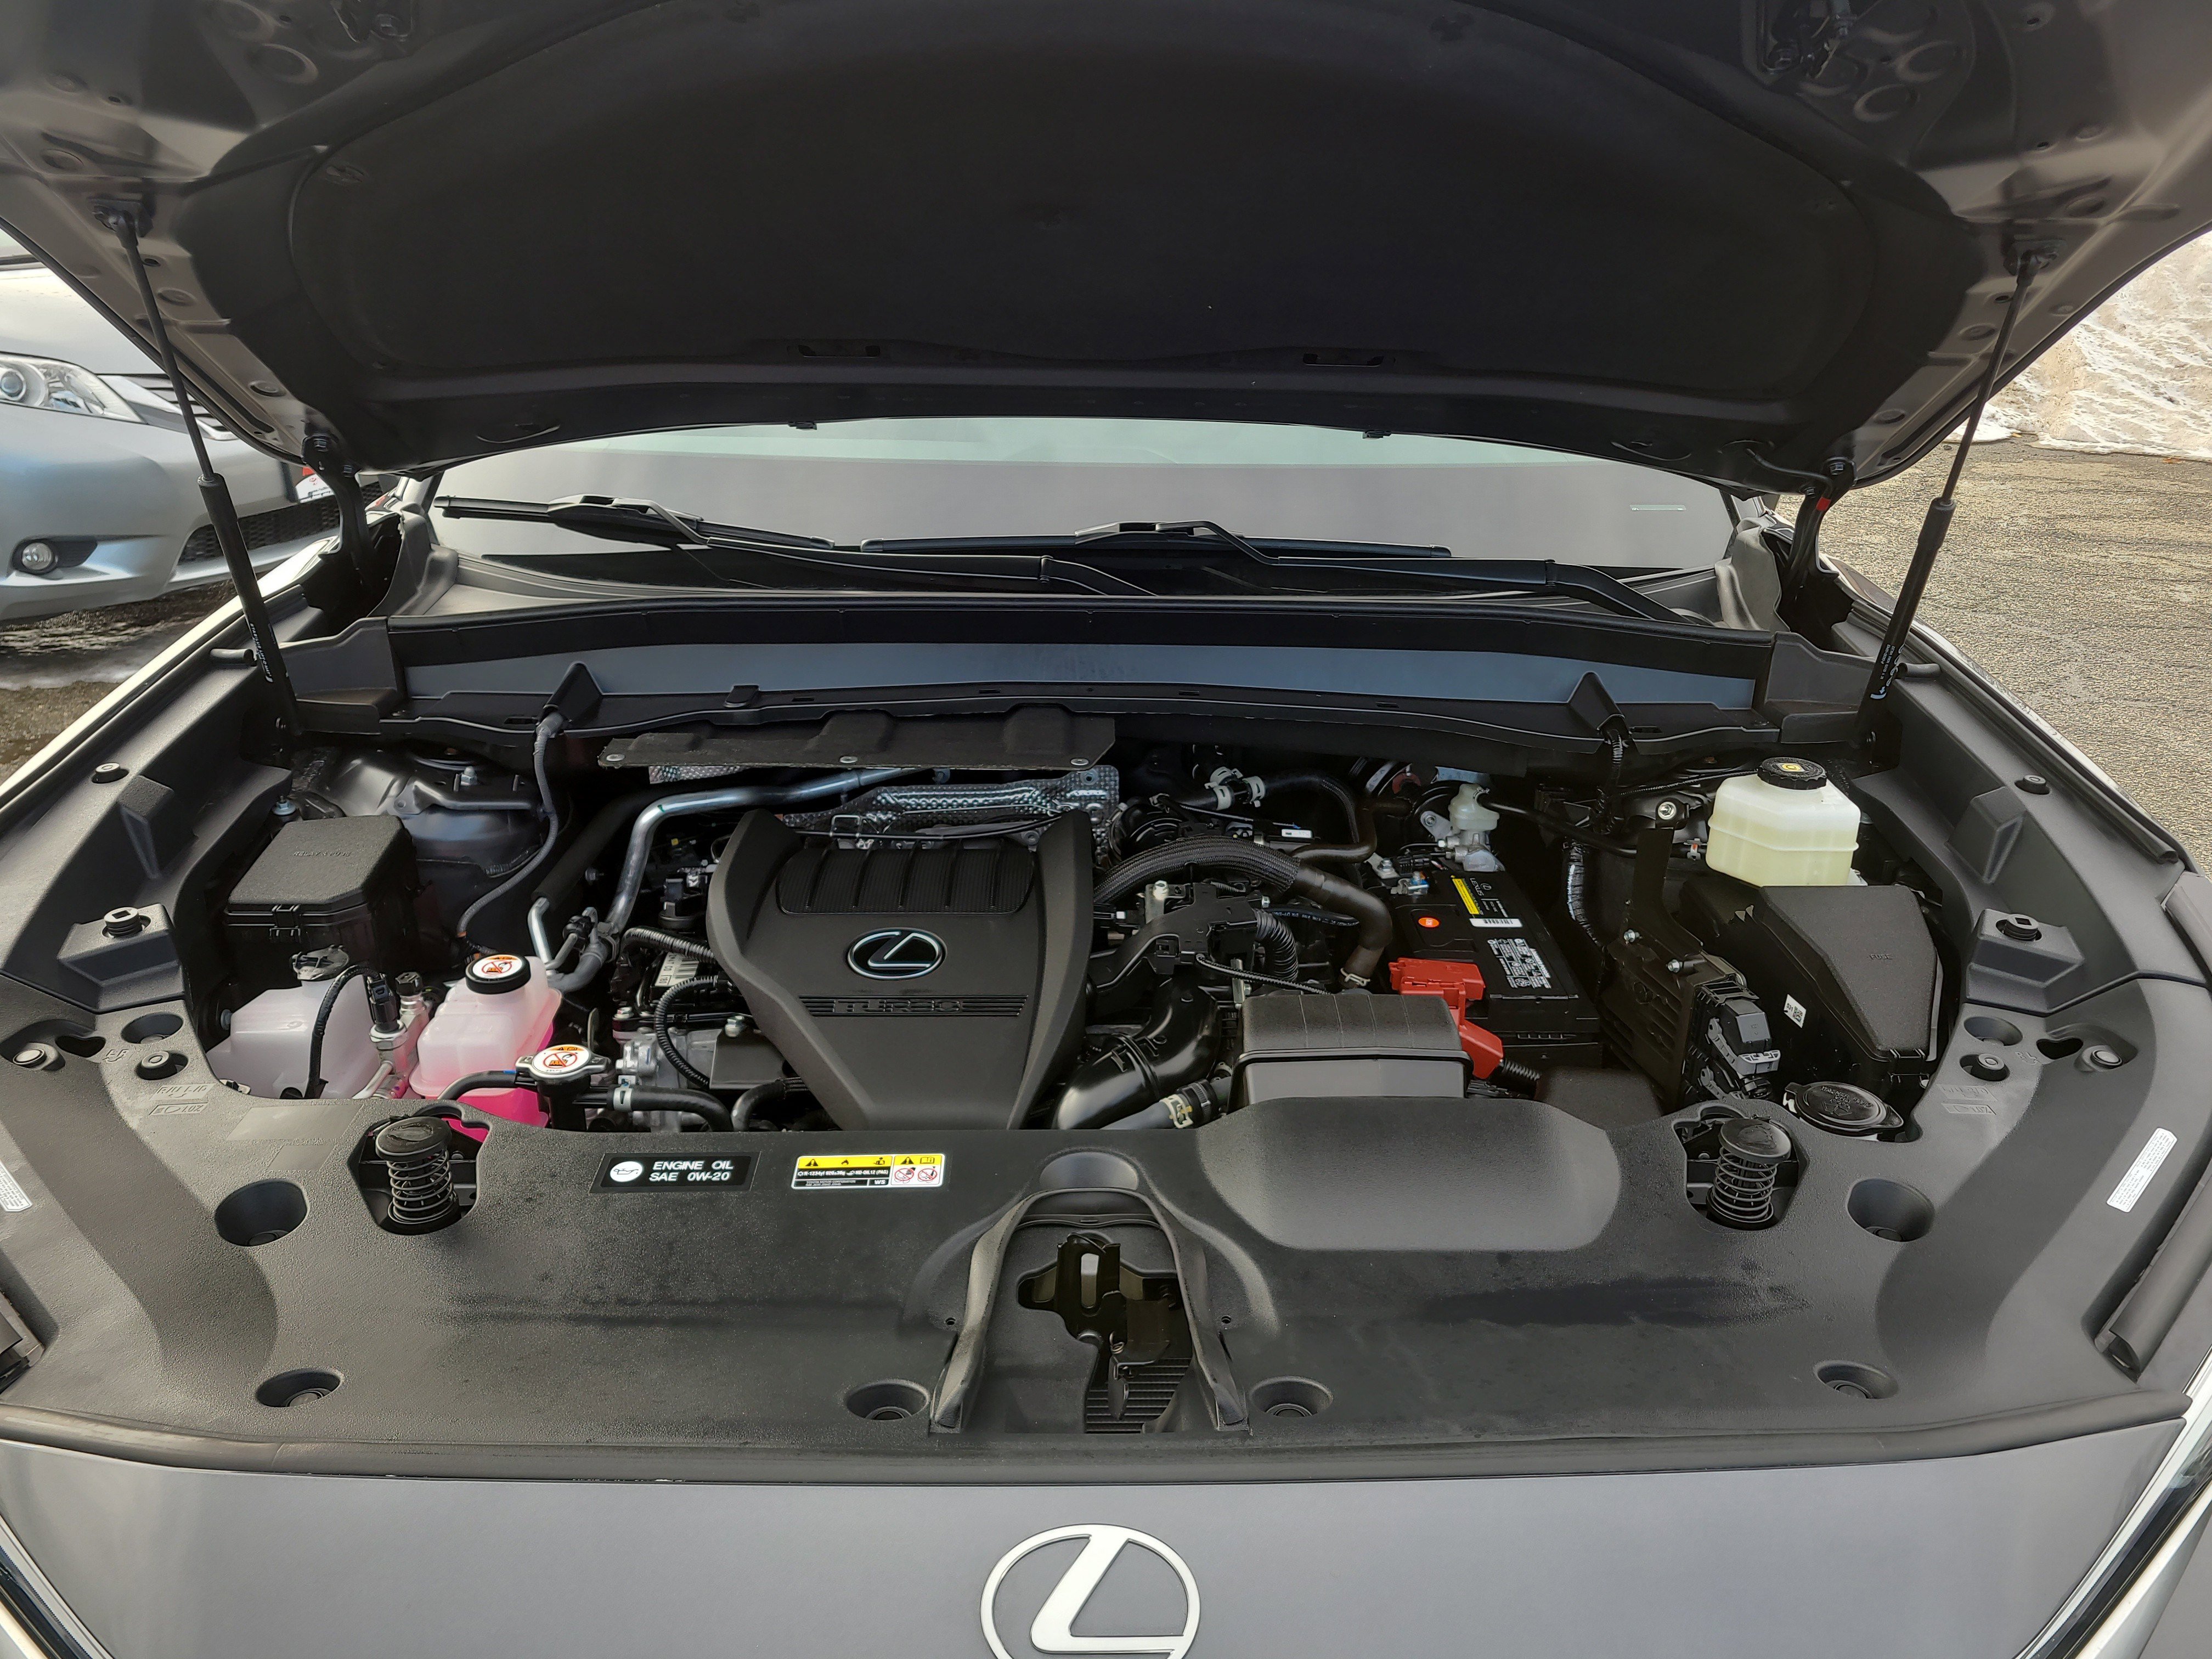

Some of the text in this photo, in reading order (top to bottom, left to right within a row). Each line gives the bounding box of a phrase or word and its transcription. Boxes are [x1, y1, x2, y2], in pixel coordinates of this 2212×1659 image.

[1470, 878, 1485, 896] LEXUS
[838, 998, 961, 1013] TURBO
[182, 1104, 204, 1113] 1.0%
[652, 1160, 735, 1171] ENGINE OIL
[649, 1171, 731, 1182] SAE 0W-20
